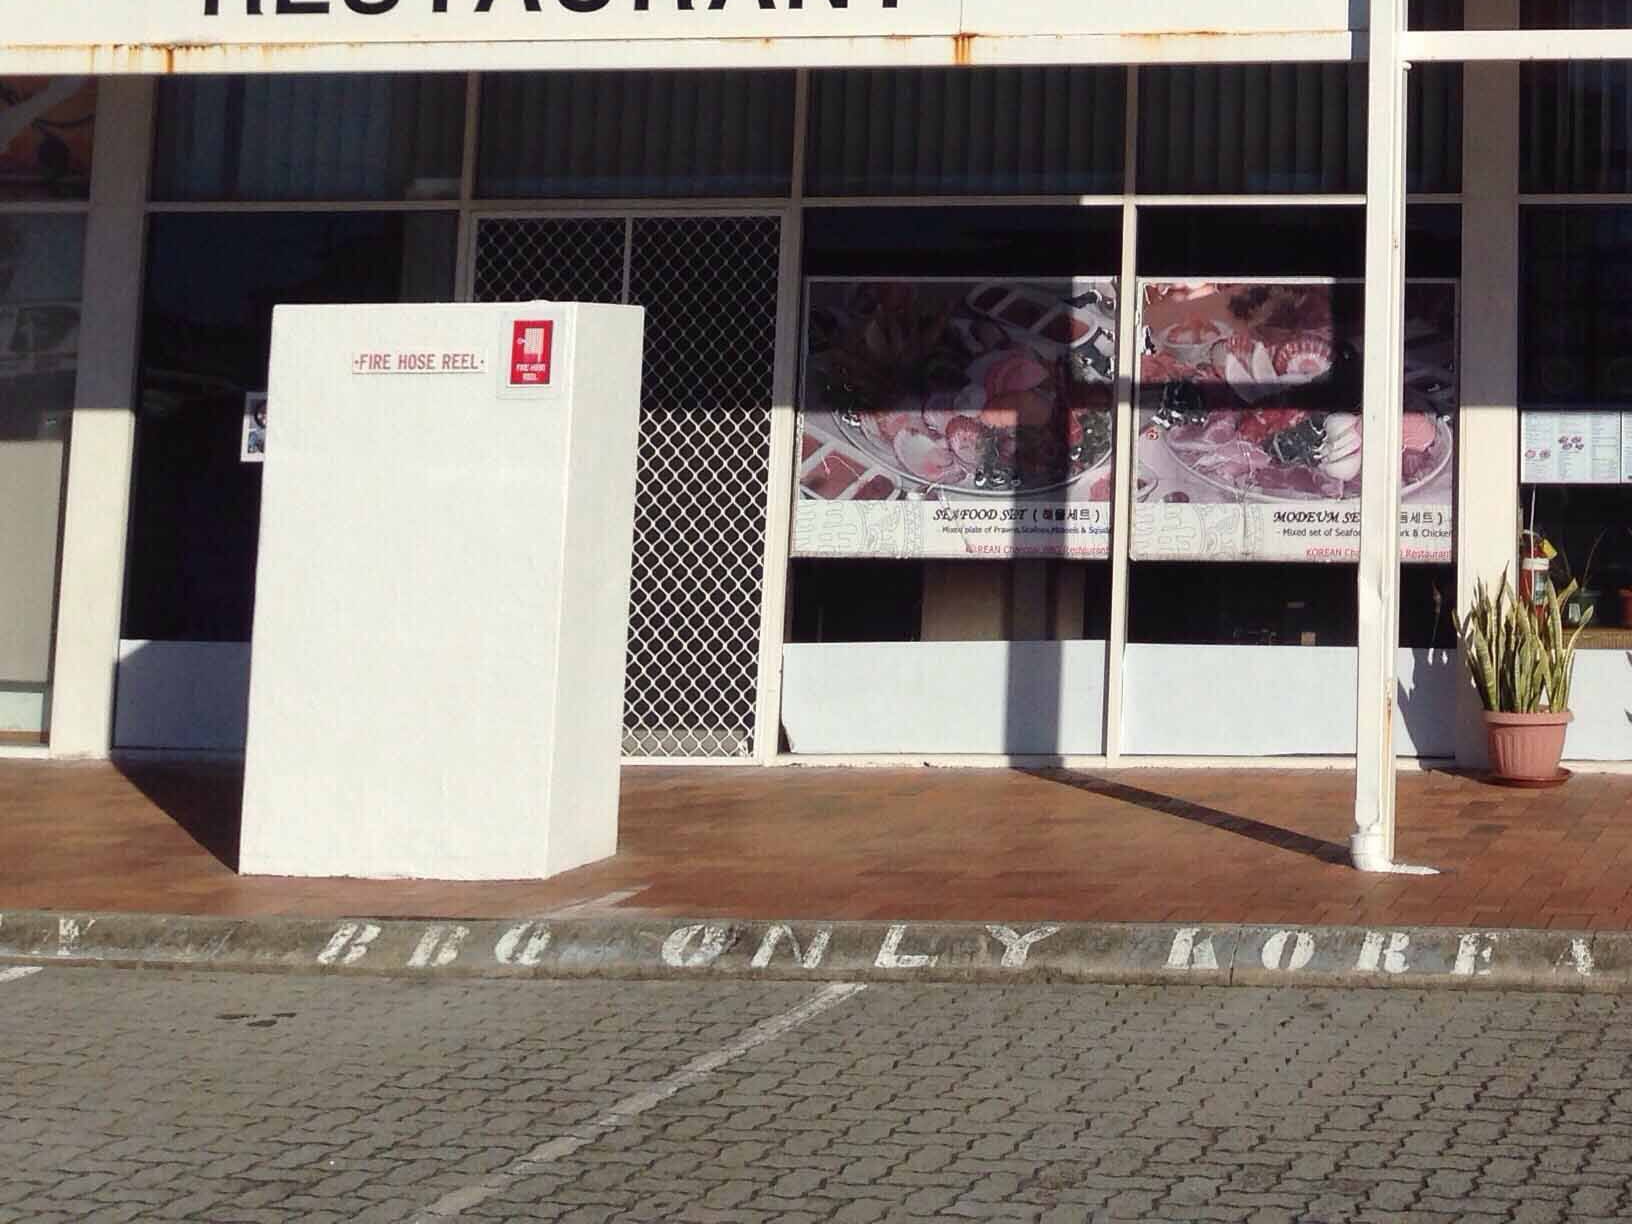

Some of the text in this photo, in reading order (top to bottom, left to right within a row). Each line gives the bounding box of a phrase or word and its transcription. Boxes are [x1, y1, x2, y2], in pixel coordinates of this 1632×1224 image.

[359, 353, 479, 370] FIRE HOSE REEL
[1342, 511, 1361, 523] SE
[1309, 528, 1322, 537] set
[1324, 528, 1333, 537] of
[661, 923, 1061, 968] ONLY
